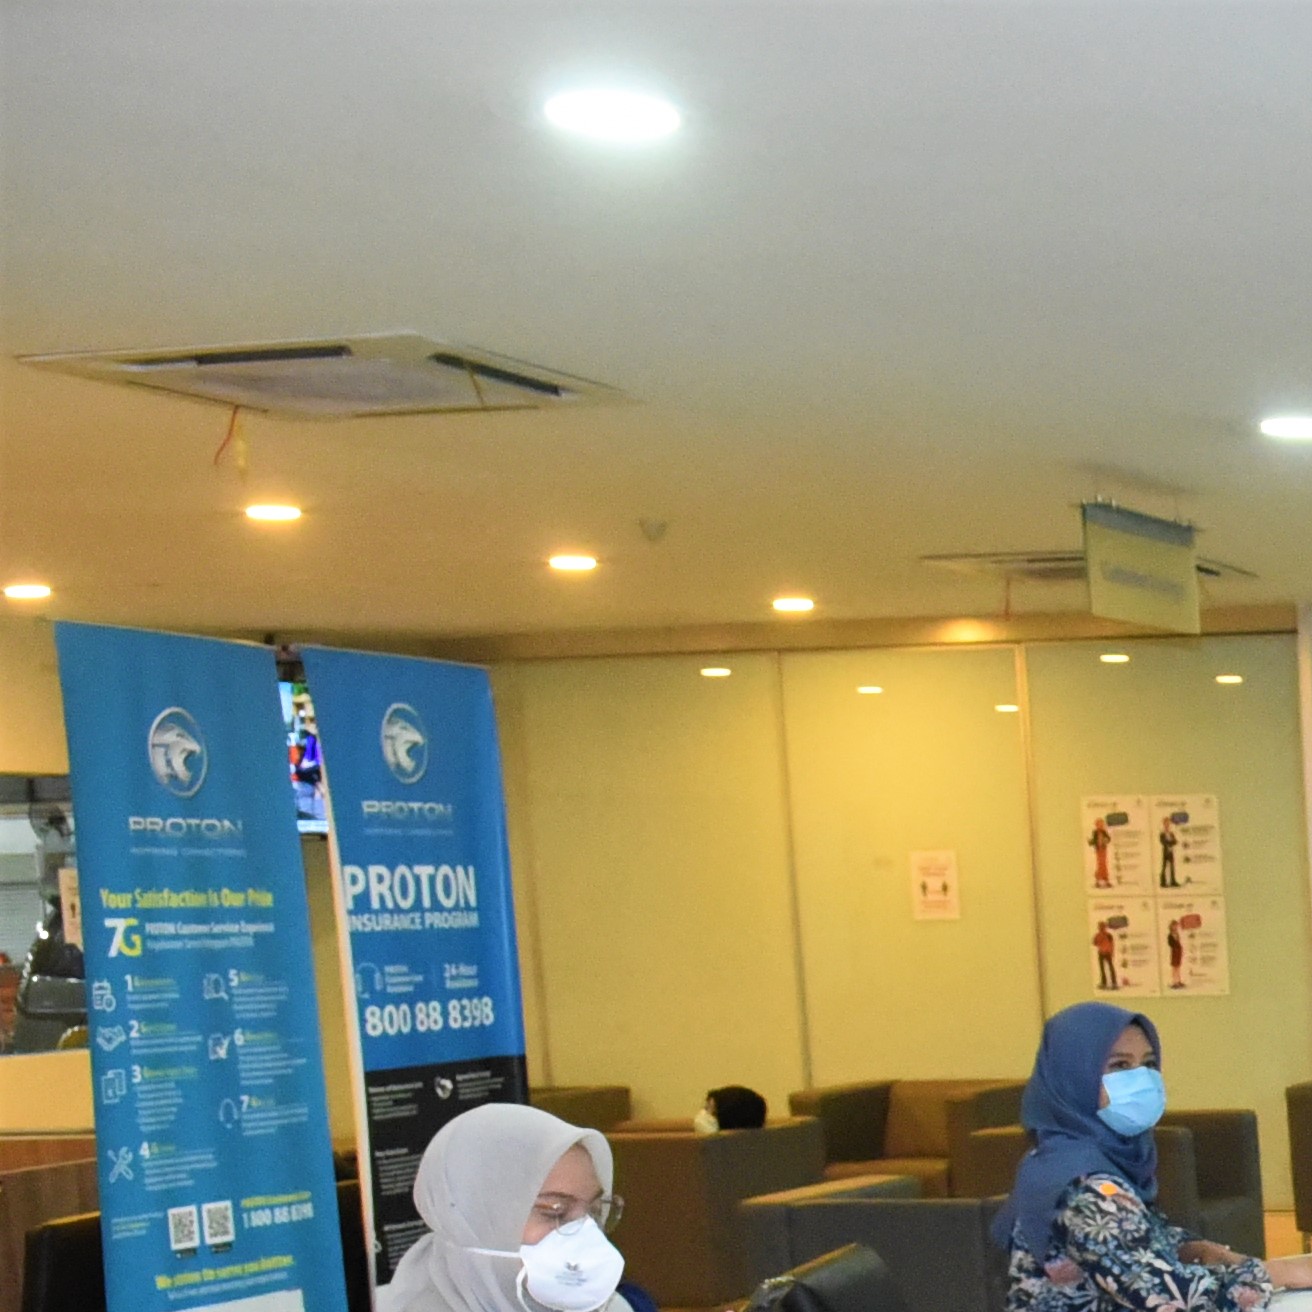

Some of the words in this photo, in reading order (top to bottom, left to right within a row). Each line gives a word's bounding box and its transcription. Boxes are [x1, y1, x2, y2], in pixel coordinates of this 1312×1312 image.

[361, 800, 453, 819] PROTON
[128, 816, 243, 838] PROTON
[342, 864, 477, 910] PROTON
[100, 888, 132, 908] Your
[425, 911, 480, 929] PROGRAM
[125, 975, 133, 992] 1
[228, 969, 238, 987] 5
[365, 1002, 411, 1037] 800
[415, 1000, 443, 1031] 88
[448, 995, 495, 1029] 8398
[129, 1020, 140, 1038] 2
[234, 1028, 244, 1046] 6
[131, 1065, 142, 1083] 3
[240, 1095, 250, 1112] 7
[139, 1141, 150, 1159] 4
